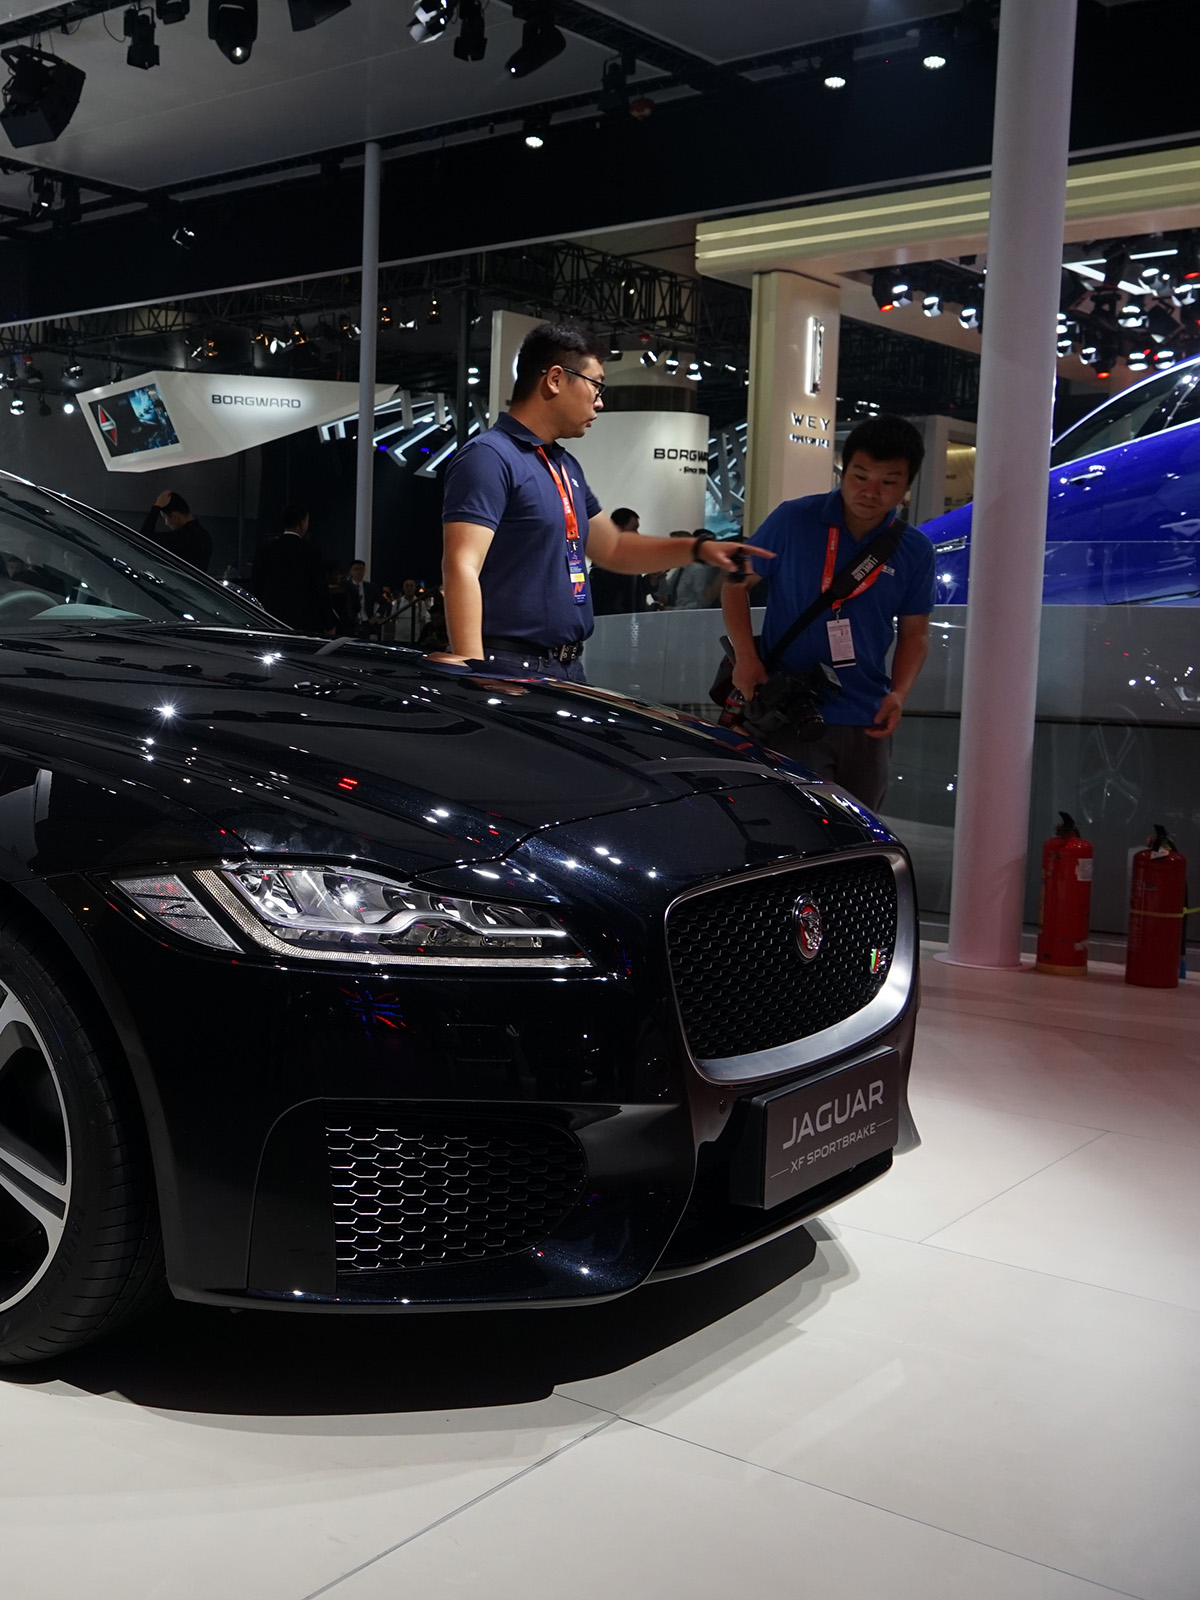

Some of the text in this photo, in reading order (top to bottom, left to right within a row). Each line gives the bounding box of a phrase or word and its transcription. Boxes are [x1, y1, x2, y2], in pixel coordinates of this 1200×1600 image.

[211, 394, 302, 409] BORGWARD
[791, 412, 830, 431] WEY
[782, 1080, 884, 1150] JAGUAR
[790, 1122, 877, 1174] XF SPORTBRAKE
